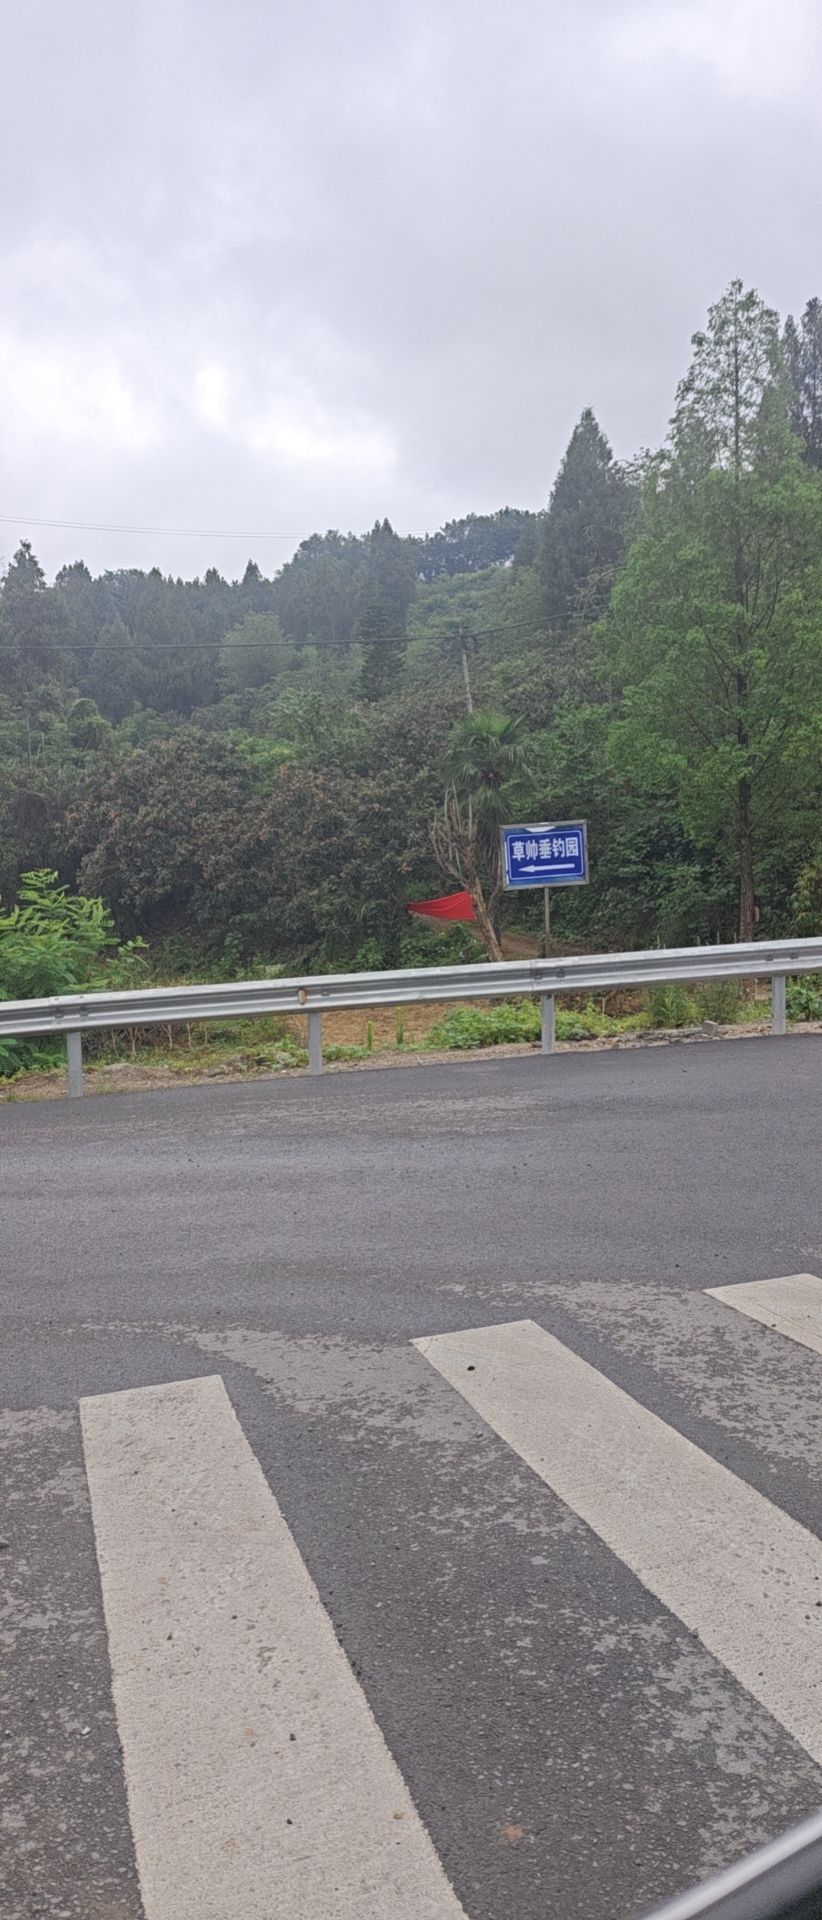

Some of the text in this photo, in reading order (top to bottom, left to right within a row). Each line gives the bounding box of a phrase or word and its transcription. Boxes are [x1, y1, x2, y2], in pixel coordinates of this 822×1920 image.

[511, 837, 579, 861] 草帅垂钓园
